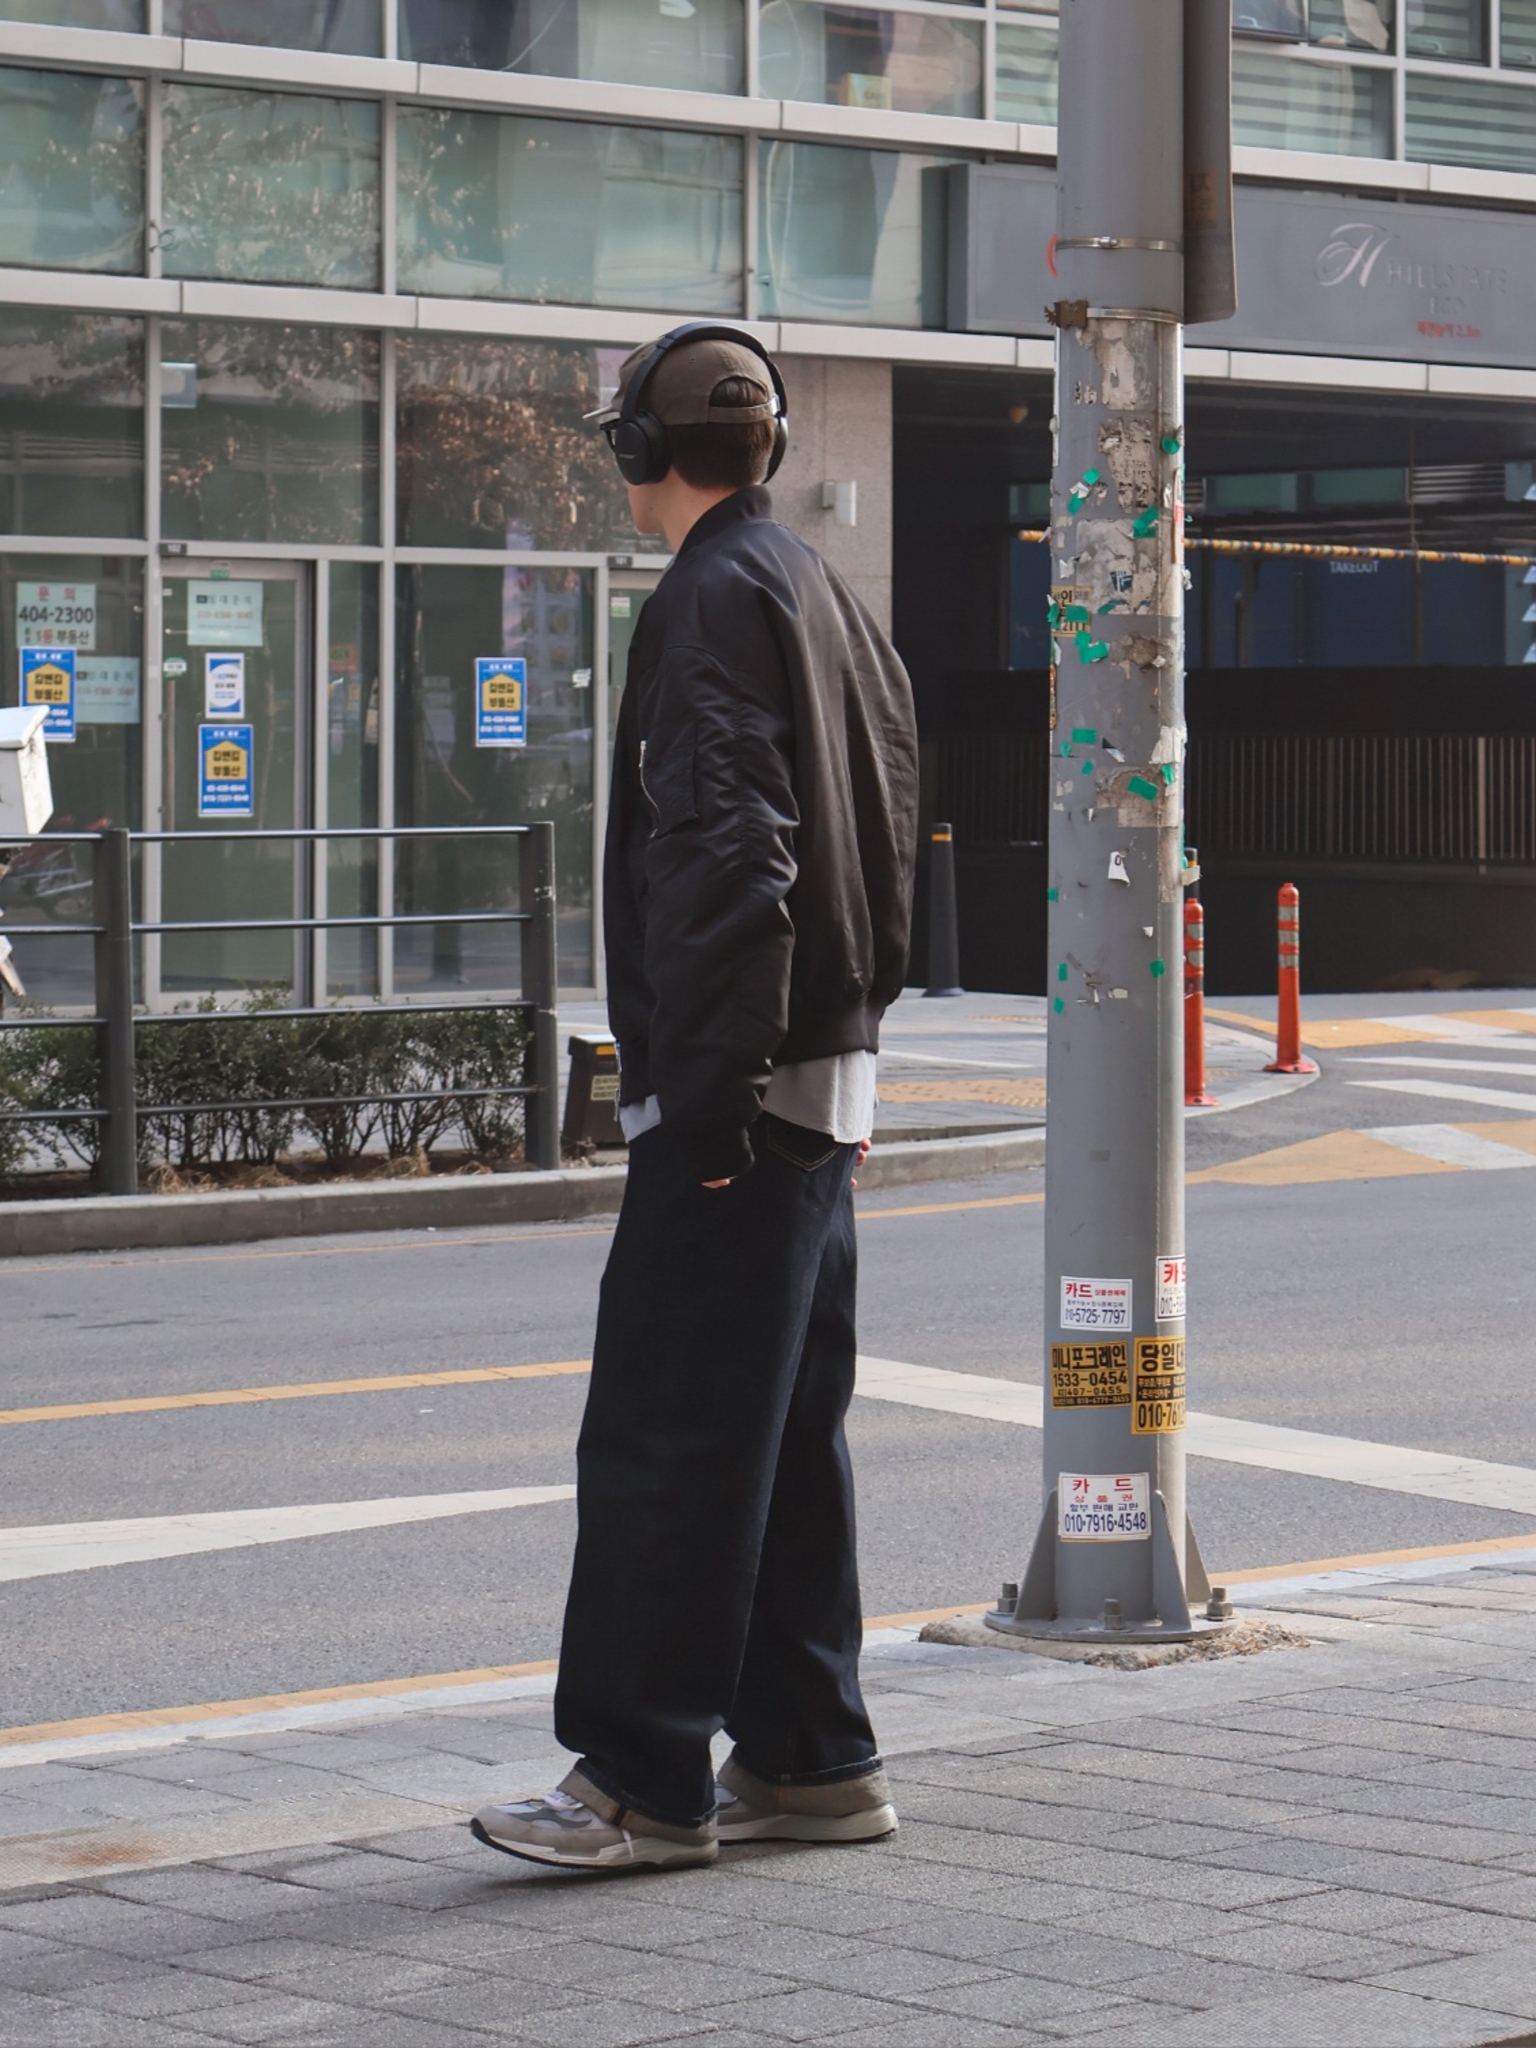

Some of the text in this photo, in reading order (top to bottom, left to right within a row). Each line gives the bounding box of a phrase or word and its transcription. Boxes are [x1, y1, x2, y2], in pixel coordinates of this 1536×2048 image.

[1387, 262, 1507, 293] HILLSTATE
[19, 605, 94, 624] 404-2300
[56, 629, 90, 645] 부동산
[1065, 1283, 1093, 1298] 카드
[1052, 1345, 1127, 1370] 미니포크레인
[1053, 1371, 1128, 1387] 1533-0454
[1092, 1503, 1114, 1512] 판매
